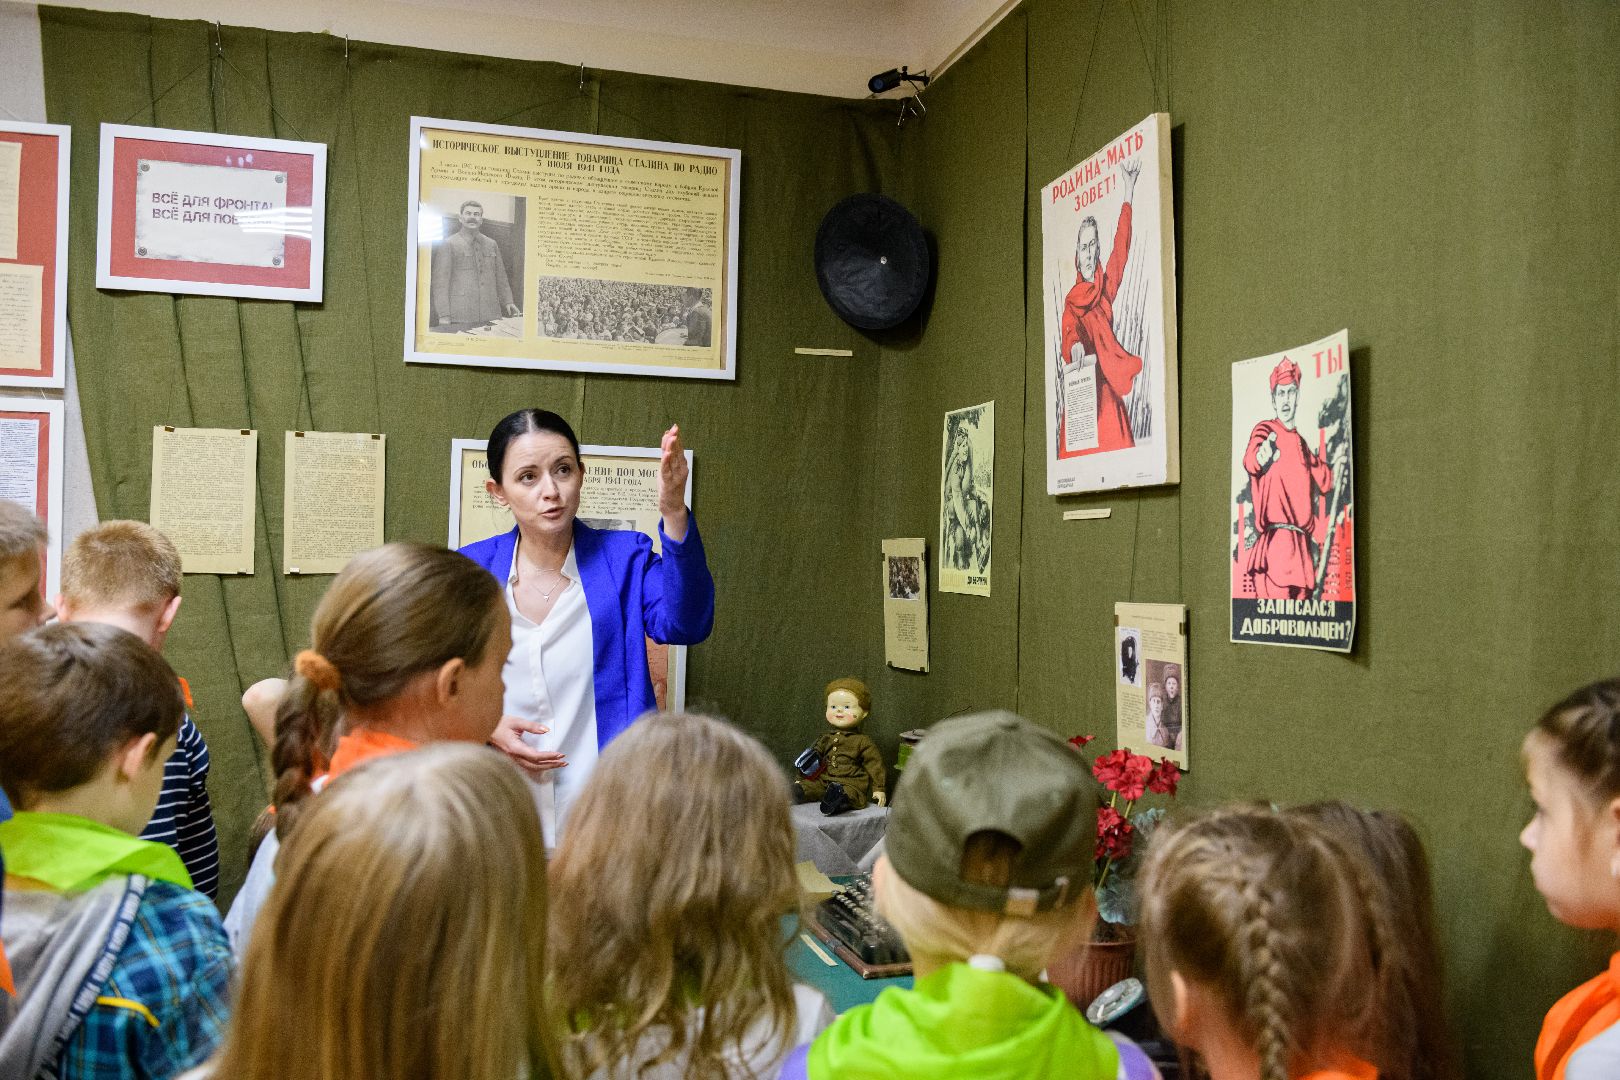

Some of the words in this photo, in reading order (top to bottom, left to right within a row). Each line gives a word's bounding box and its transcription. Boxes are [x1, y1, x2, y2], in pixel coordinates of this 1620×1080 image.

[432, 139, 500, 155] ИСТОРИЧЕСКОЕ
[504, 145, 571, 161] ВЫСТУПЛЕНИЕ
[575, 152, 624, 167] ТОВАРИЩА
[628, 157, 669, 171] СТАЛИНА
[673, 162, 685, 173] ПО
[689, 164, 718, 177] РАДИО
[547, 160, 573, 170] ИЮЛЯ
[577, 163, 595, 173] 1941
[599, 165, 621, 175] ГОДА
[1052, 131, 1144, 205] РОДИНА-МАТЬ
[152, 191, 179, 205] ВСЁ
[182, 194, 210, 208] ДЛЯ
[1074, 173, 1117, 212] ЗОВЕТ!
[152, 207, 179, 221] ВСЁ
[182, 210, 211, 223] ДЛЯ
[1312, 343, 1343, 378] ТЫ
[605, 476, 621, 485] 1941
[623, 478, 642, 486] ГОДА
[1257, 598, 1336, 617] ЗАПИСАЛСЯ
[1240, 617, 1351, 641] ДОБРОВОЛЬЦЕМ?
